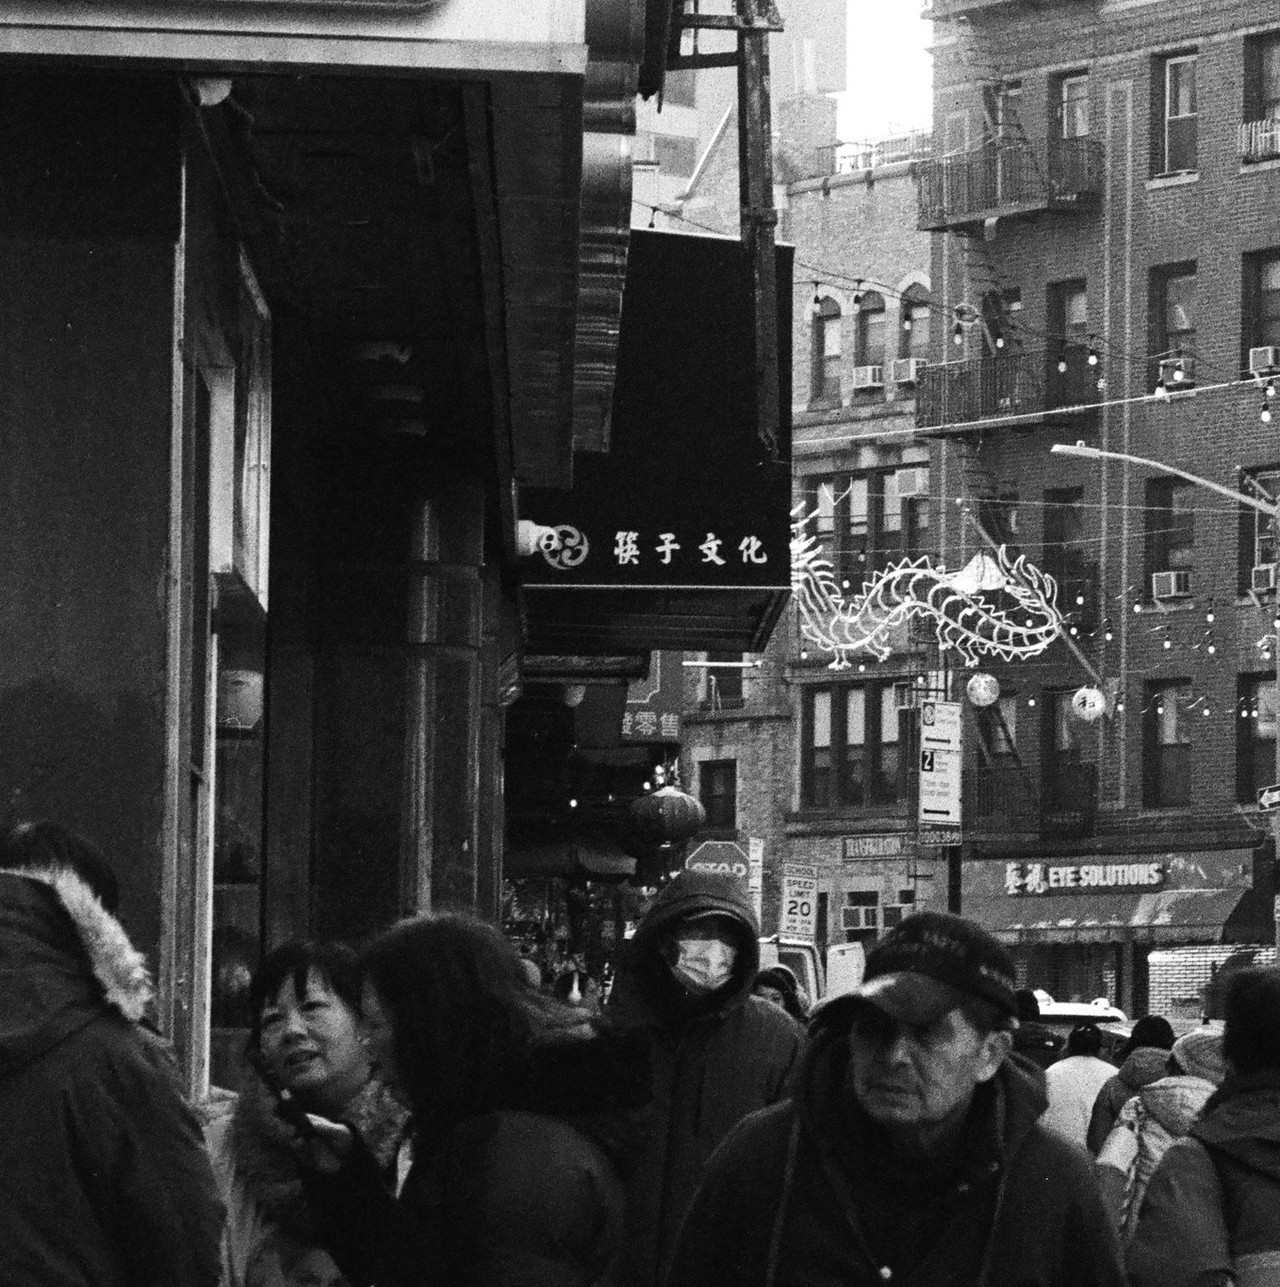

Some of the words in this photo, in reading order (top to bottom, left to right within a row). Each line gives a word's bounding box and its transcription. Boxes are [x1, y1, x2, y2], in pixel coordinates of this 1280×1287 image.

[614, 530, 768, 565] 筷子文化
[786, 879, 816, 890] SPEED
[1048, 865, 1078, 888] EYE
[1079, 862, 1163, 887] SOLUTIONS
[786, 899, 812, 917] 20
